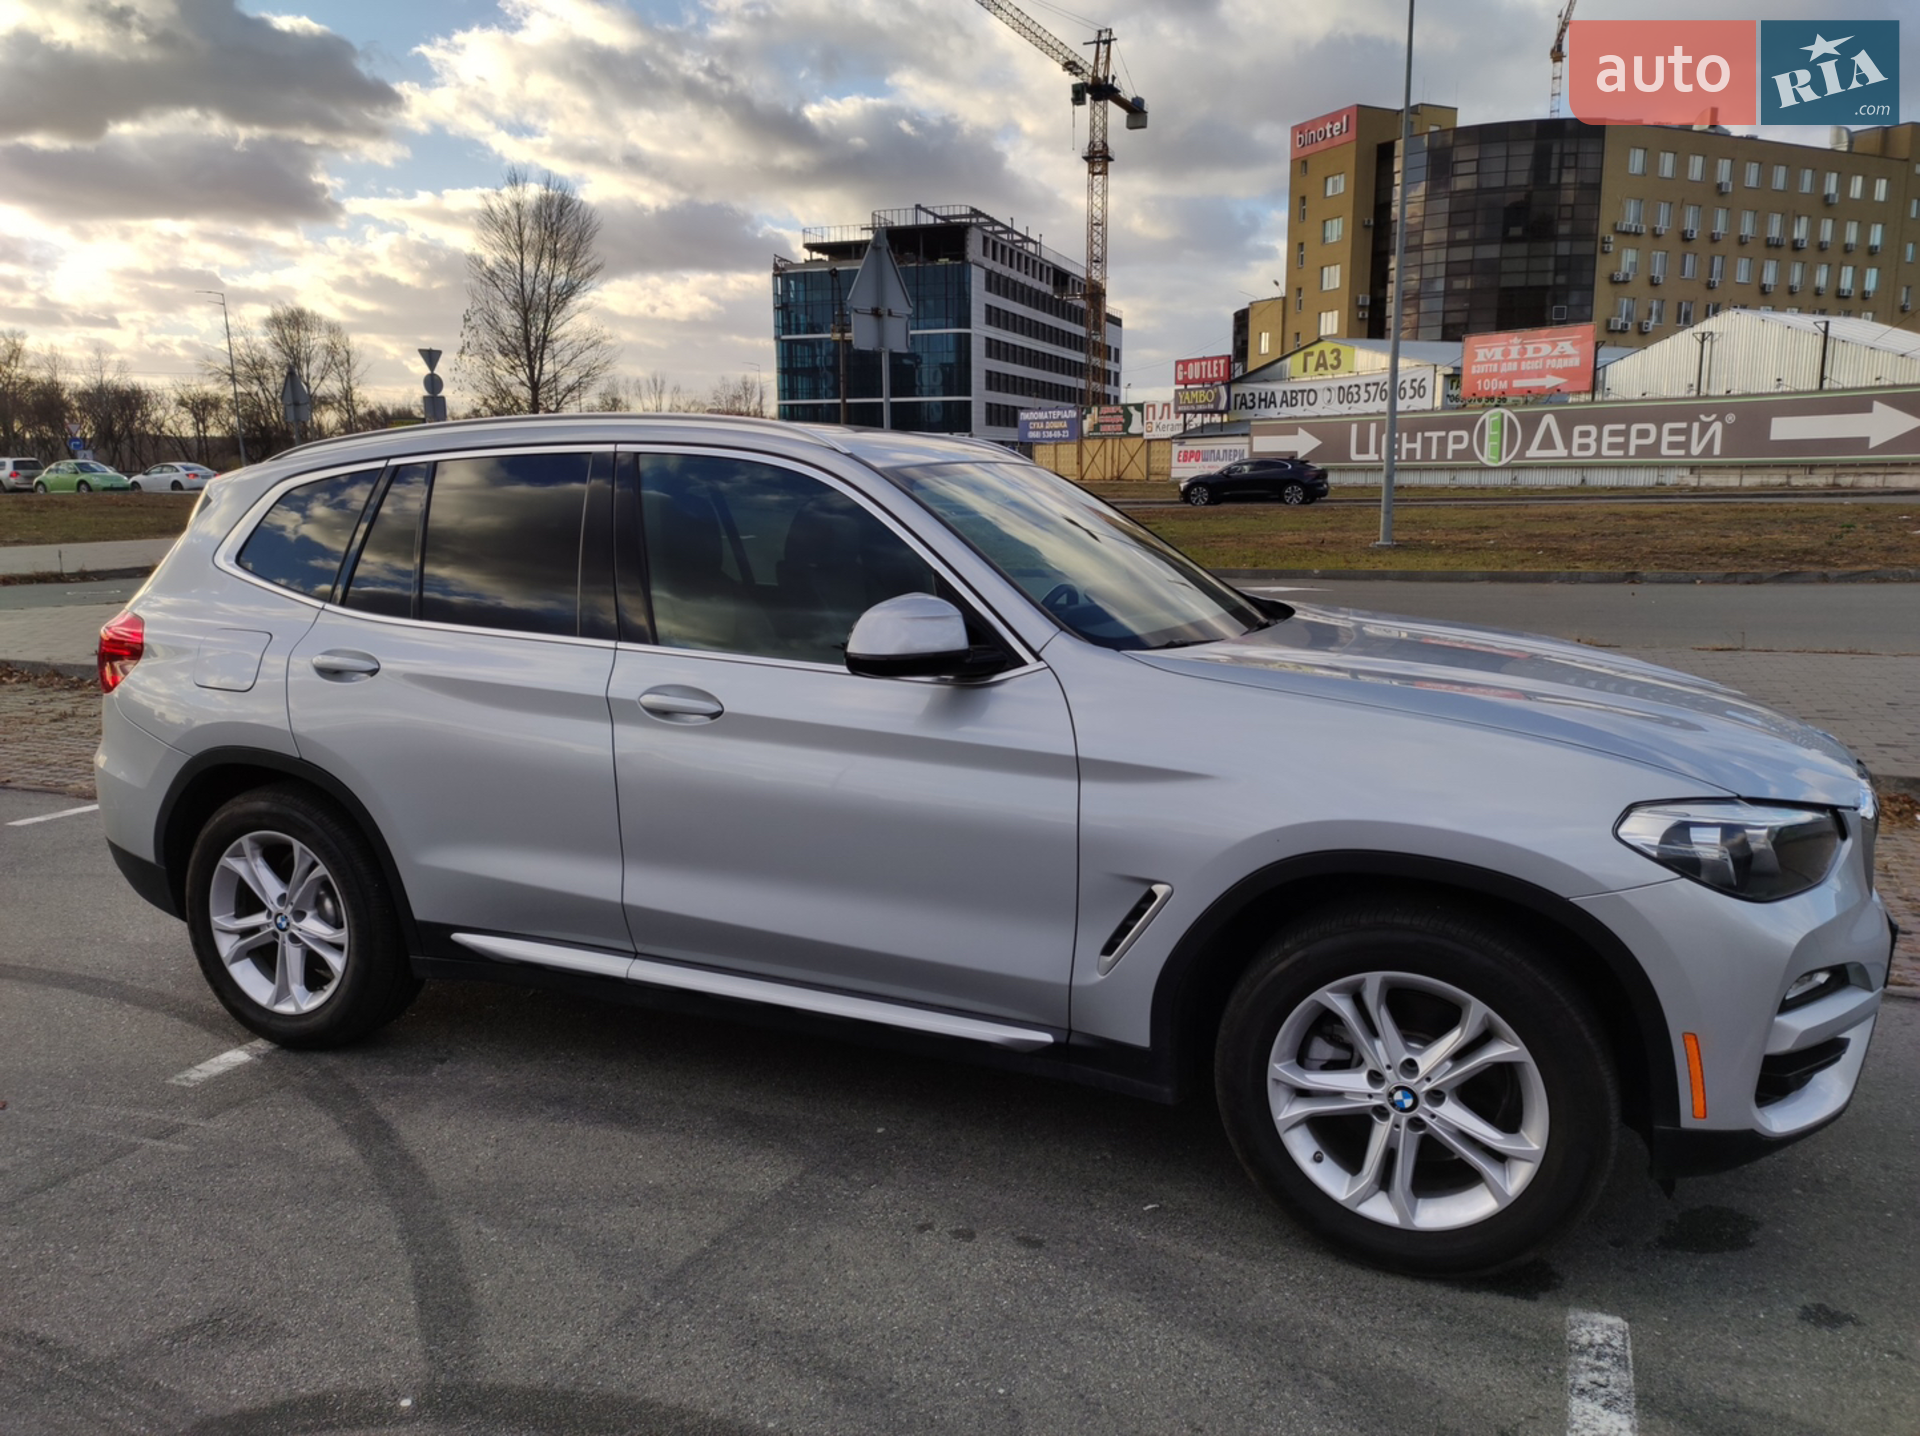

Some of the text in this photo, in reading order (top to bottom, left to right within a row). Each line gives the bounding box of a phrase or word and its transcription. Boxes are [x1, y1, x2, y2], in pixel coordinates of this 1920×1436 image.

[1296, 114, 1349, 148] binotel
[1177, 359, 1225, 381] G-OUTLET
[1302, 348, 1342, 373] ГАЗ
[1500, 362, 1517, 373] ДЛЯ
[1546, 357, 1581, 369] РОДИНИ
[1233, 391, 1257, 411] ГАЗ
[1258, 391, 1278, 409] НА
[1280, 388, 1318, 408] АВТО
[1337, 384, 1361, 405] 063
[1363, 381, 1388, 403] 576
[1409, 377, 1426, 399] 56
